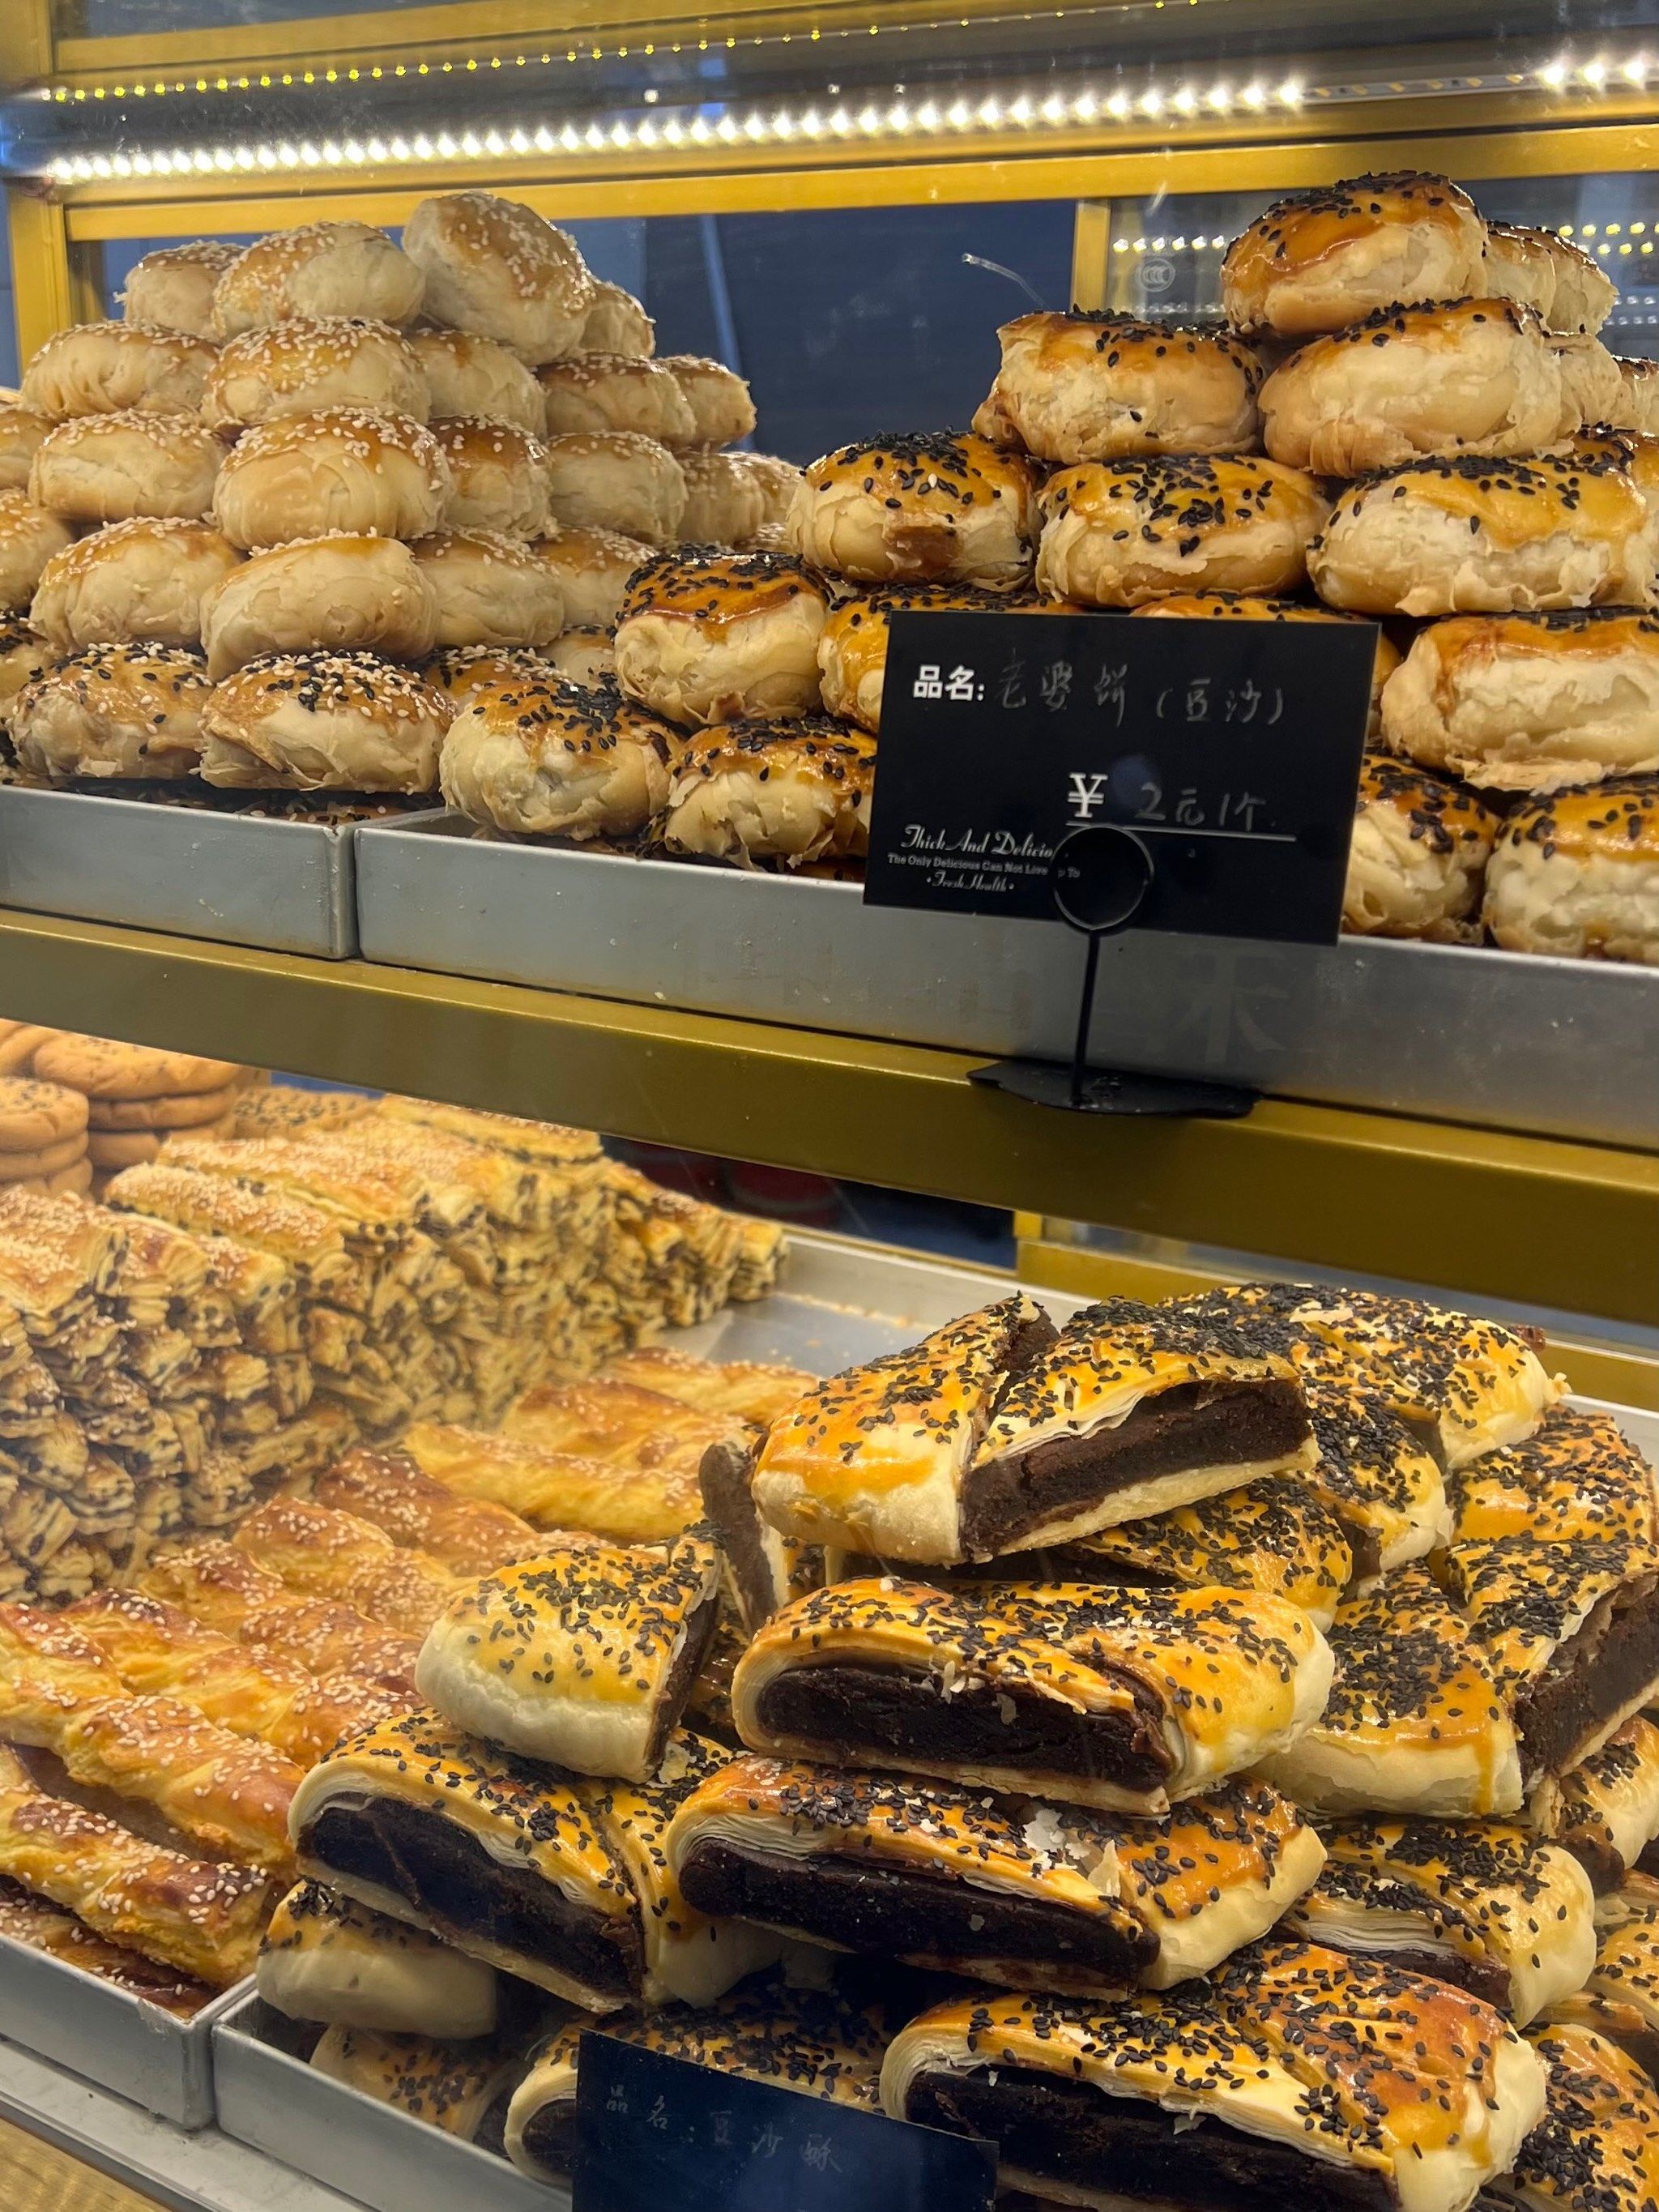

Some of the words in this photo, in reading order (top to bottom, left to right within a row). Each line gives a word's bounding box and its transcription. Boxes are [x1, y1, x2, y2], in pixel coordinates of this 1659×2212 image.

[913, 663, 986, 702] 品名:
[901, 823, 946, 850] Thick
[945, 827, 991, 852] And
[991, 831, 1054, 858] Delicio
[887, 852, 906, 865] The
[908, 853, 932, 868] Only
[933, 856, 980, 870] Delicious
[982, 859, 1004, 872] Can
[1004, 861, 1024, 874] Not
[932, 869, 964, 889] Fresh
